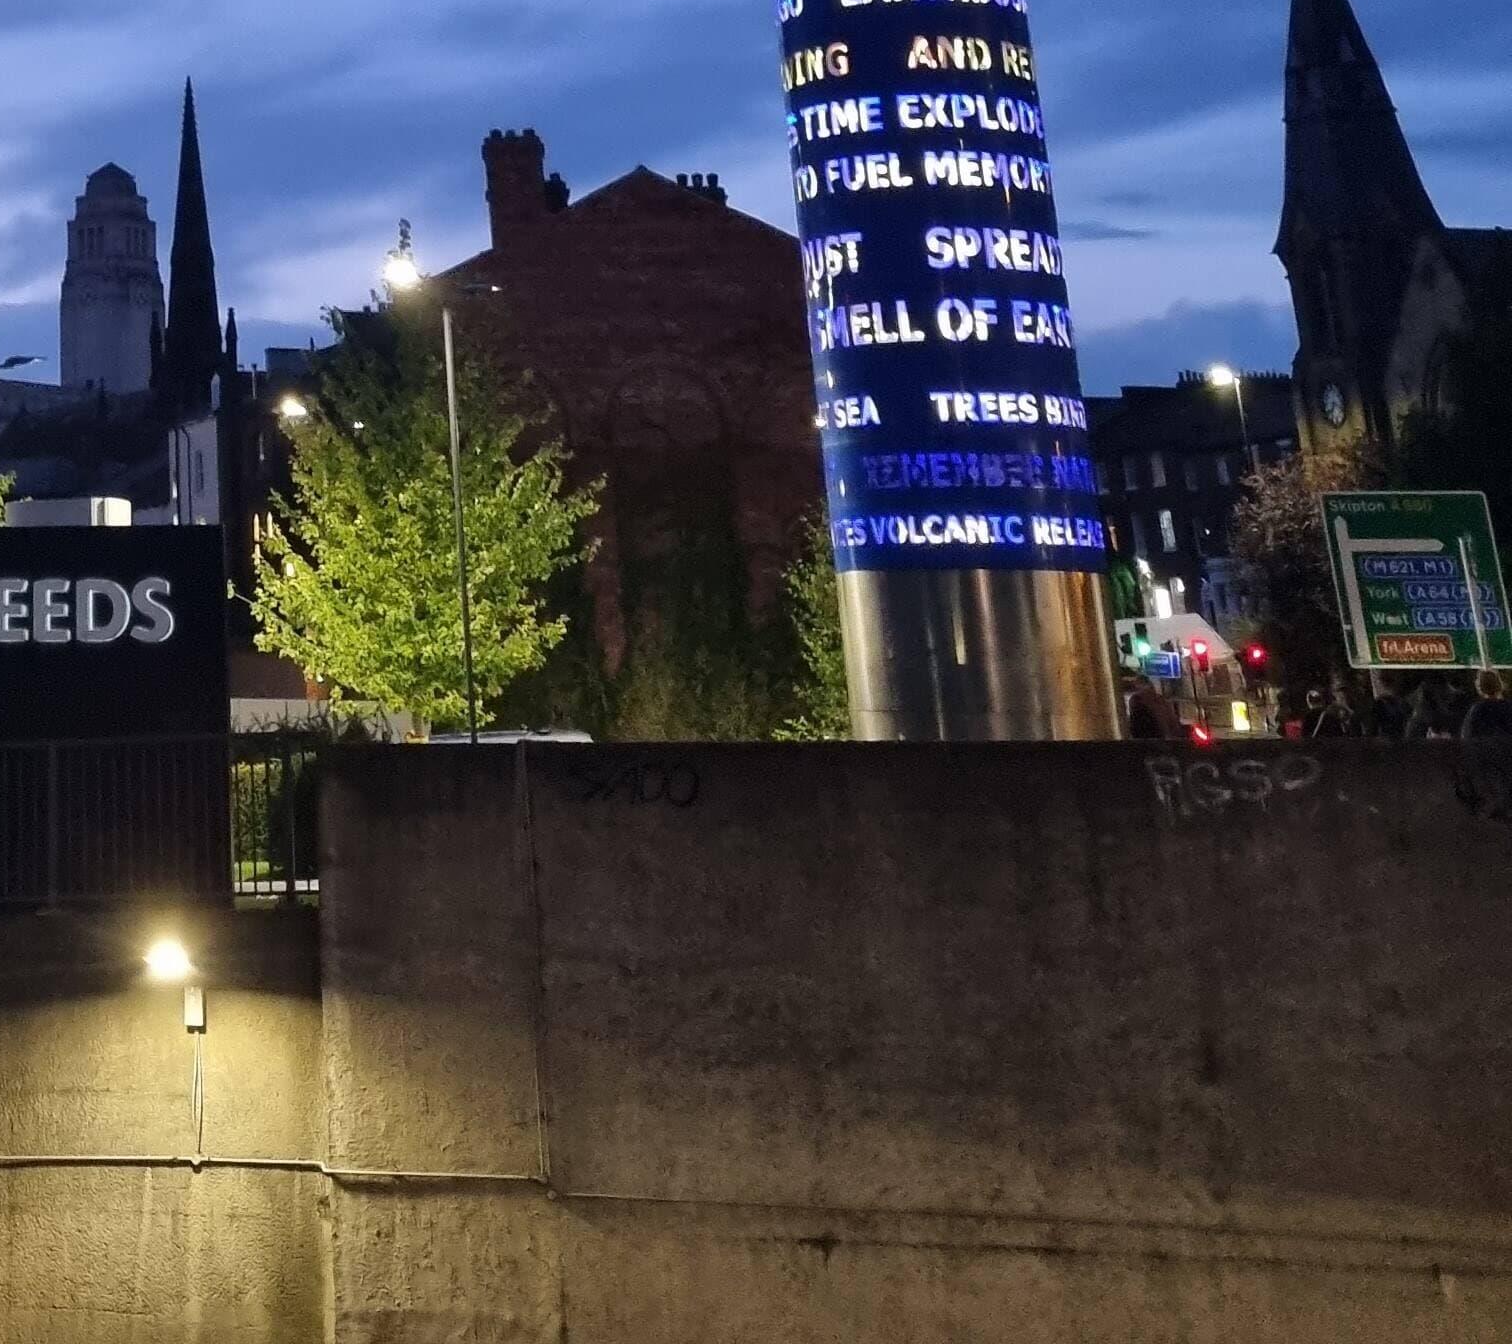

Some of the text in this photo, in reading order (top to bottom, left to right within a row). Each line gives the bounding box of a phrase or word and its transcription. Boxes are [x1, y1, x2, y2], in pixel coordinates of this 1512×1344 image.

[907, 35, 992, 71] AND
[799, 97, 883, 141] TIME
[825, 153, 913, 194] FUEL
[937, 297, 999, 343] OF
[835, 395, 881, 428] SEA
[929, 391, 1038, 424] TREES
[1329, 500, 1385, 514] Skipton
[870, 515, 1025, 545] VOLCANIC
[1367, 586, 1399, 600] York
[1404, 640, 1448, 654] Arena
